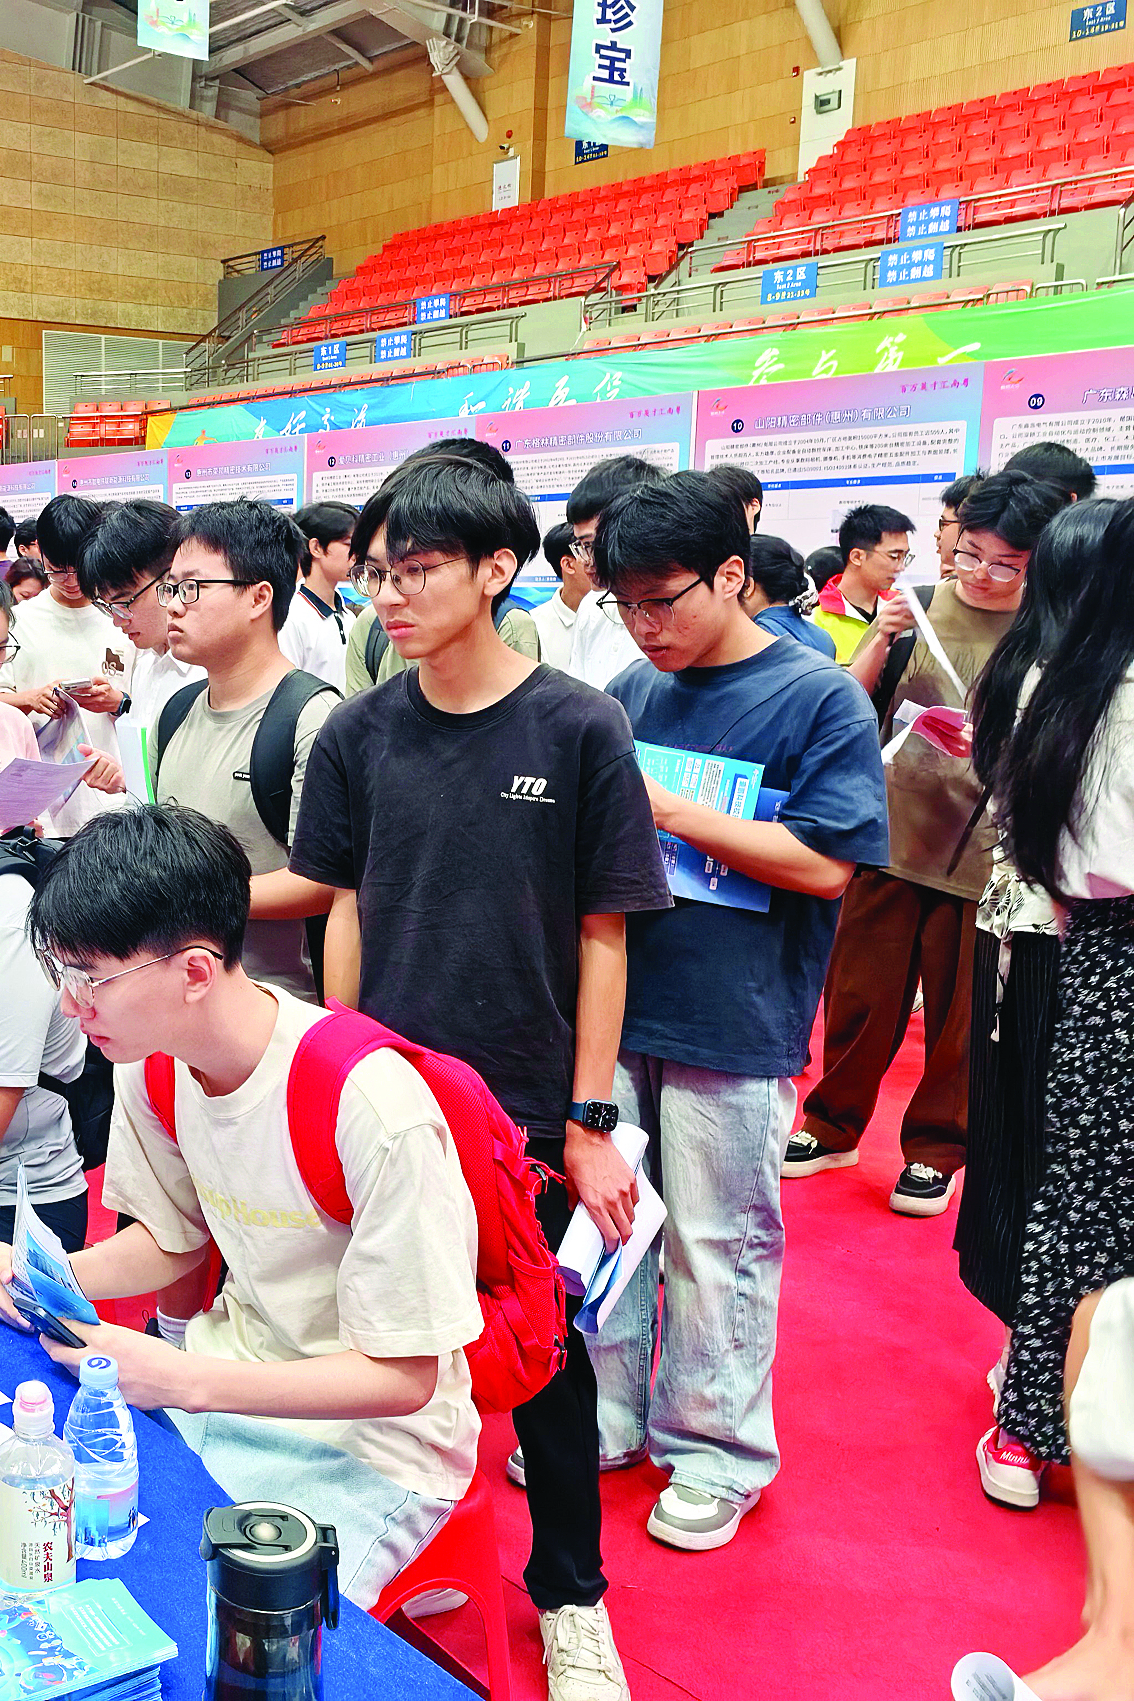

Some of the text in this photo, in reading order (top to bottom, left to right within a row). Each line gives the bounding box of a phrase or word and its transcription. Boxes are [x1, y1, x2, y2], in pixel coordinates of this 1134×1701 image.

[592, 0, 637, 87] 珍宝
[907, 204, 951, 223] 禁止攀爬
[906, 219, 950, 238] 禁止翻越
[887, 248, 936, 267] 禁止攀爬
[773, 266, 807, 284] 东2区
[886, 264, 934, 283] 禁止翻越
[1029, 396, 1044, 407] 09
[732, 421, 744, 431] 10
[510, 775, 548, 796] YTO
[43, 1541, 54, 1583] 农夫山泉
